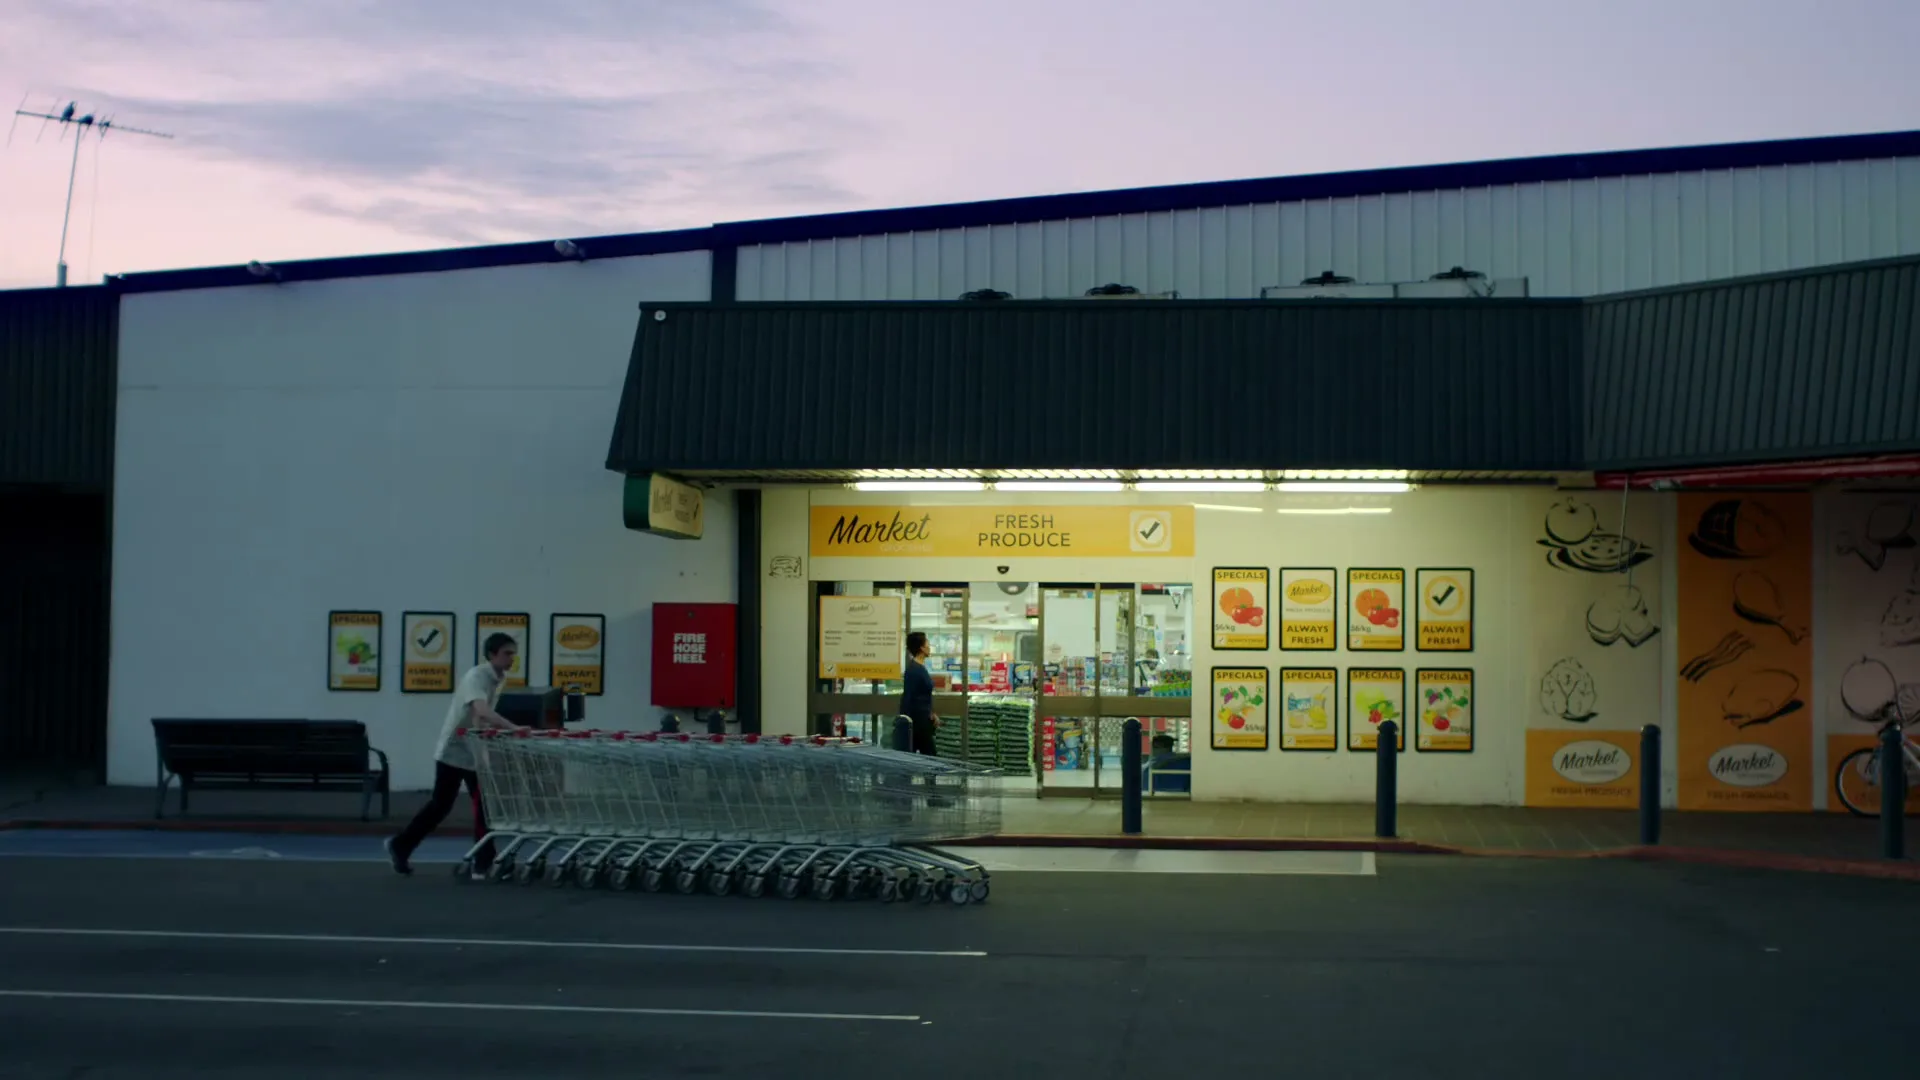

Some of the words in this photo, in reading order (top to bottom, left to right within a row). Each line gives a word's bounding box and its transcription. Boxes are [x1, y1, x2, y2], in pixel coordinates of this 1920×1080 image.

[995, 514, 1054, 529] FRESH
[828, 511, 931, 545] Market
[978, 533, 1071, 547] PRODUCE
[1217, 571, 1265, 579] SPECIALS
[1353, 572, 1401, 580] SPECIALS
[1287, 625, 1329, 633] ALWAYS
[1423, 626, 1465, 634] ALWAYS
[674, 633, 706, 643] FIRE
[1291, 636, 1324, 644] FRESH
[1427, 637, 1460, 645] FRESH
[673, 643, 706, 653] HOSE
[673, 653, 707, 664] REEL
[1216, 671, 1264, 679] SPECIALS
[1285, 671, 1333, 679] SPECIALS
[1353, 671, 1401, 679] SPECIALS
[1421, 672, 1469, 680] SPECIALS
[1559, 748, 1619, 770] Market
[1716, 752, 1776, 774] Market
